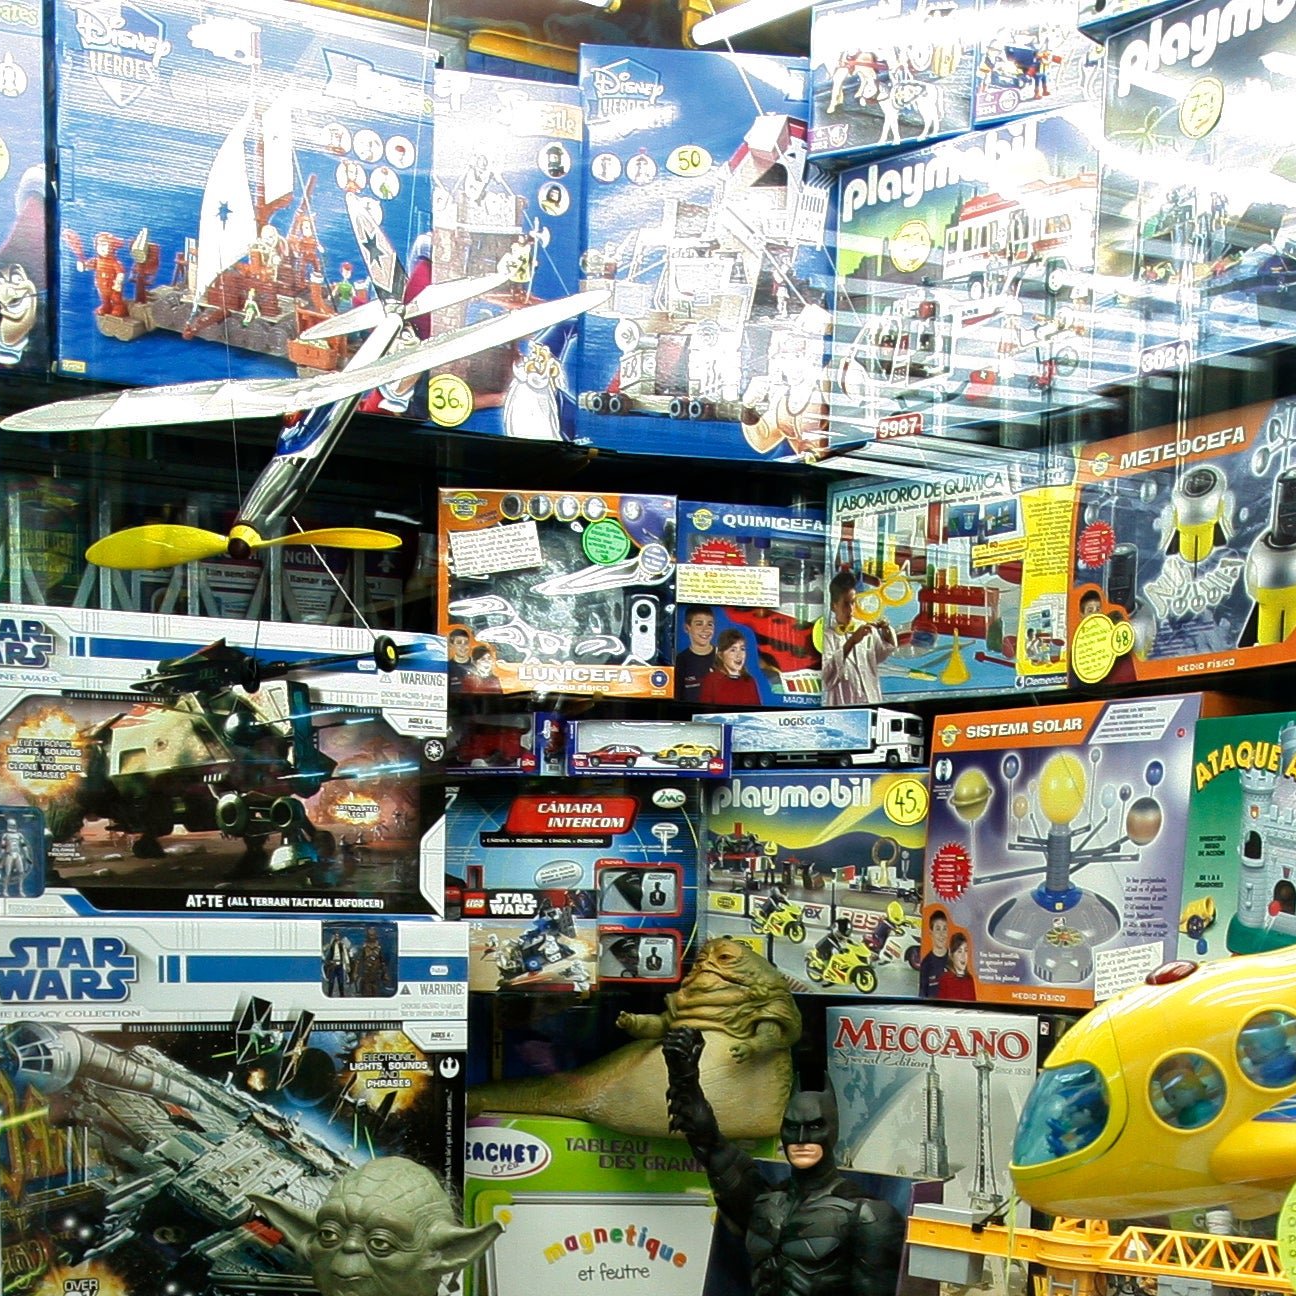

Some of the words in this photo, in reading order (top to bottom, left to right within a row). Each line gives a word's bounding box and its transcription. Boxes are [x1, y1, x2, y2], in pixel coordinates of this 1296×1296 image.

[89, 52, 156, 81] HEROES
[593, 69, 663, 101] Disney
[678, 151, 701, 170] 50
[880, 418, 919, 440] 9987
[1119, 426, 1245, 470] METEOCEFA
[836, 484, 922, 513] LABORATORIO
[924, 482, 942, 499] DE
[722, 512, 824, 532] QUIMICEFA
[518, 665, 633, 684] LUNICEFA
[965, 722, 1029, 740] SISTEMA
[1031, 716, 1083, 735] SOLAR
[44, 748, 83, 757] SOUNDS
[1194, 741, 1281, 790] ATAQUE
[711, 776, 872, 814] playmobil
[537, 799, 604, 816] CÁMARA
[547, 813, 625, 832] INTERCOM
[185, 895, 224, 908] AT-TE
[227, 897, 247, 909] (ALL
[248, 897, 290, 909] TERRAIN
[291, 898, 334, 909] TACTICAL
[335, 898, 384, 911] ENFORCER)
[489, 893, 534, 904] STAR
[490, 903, 538, 916] WARS
[420, 983, 465, 997] WARNING:
[17, 1009, 61, 1019] LEGACY
[64, 1009, 142, 1019] COLLECTION
[833, 1015, 1032, 1062] MECCANO
[388, 1061, 428, 1072] SOUNDS
[883, 1053, 931, 1070] Edition
[366, 1078, 411, 1088] PHRASES
[543, 1223, 688, 1268] magnetique
[577, 1262, 595, 1282] et
[599, 1263, 650, 1282] feutre
[64, 1279, 99, 1291] OVER
